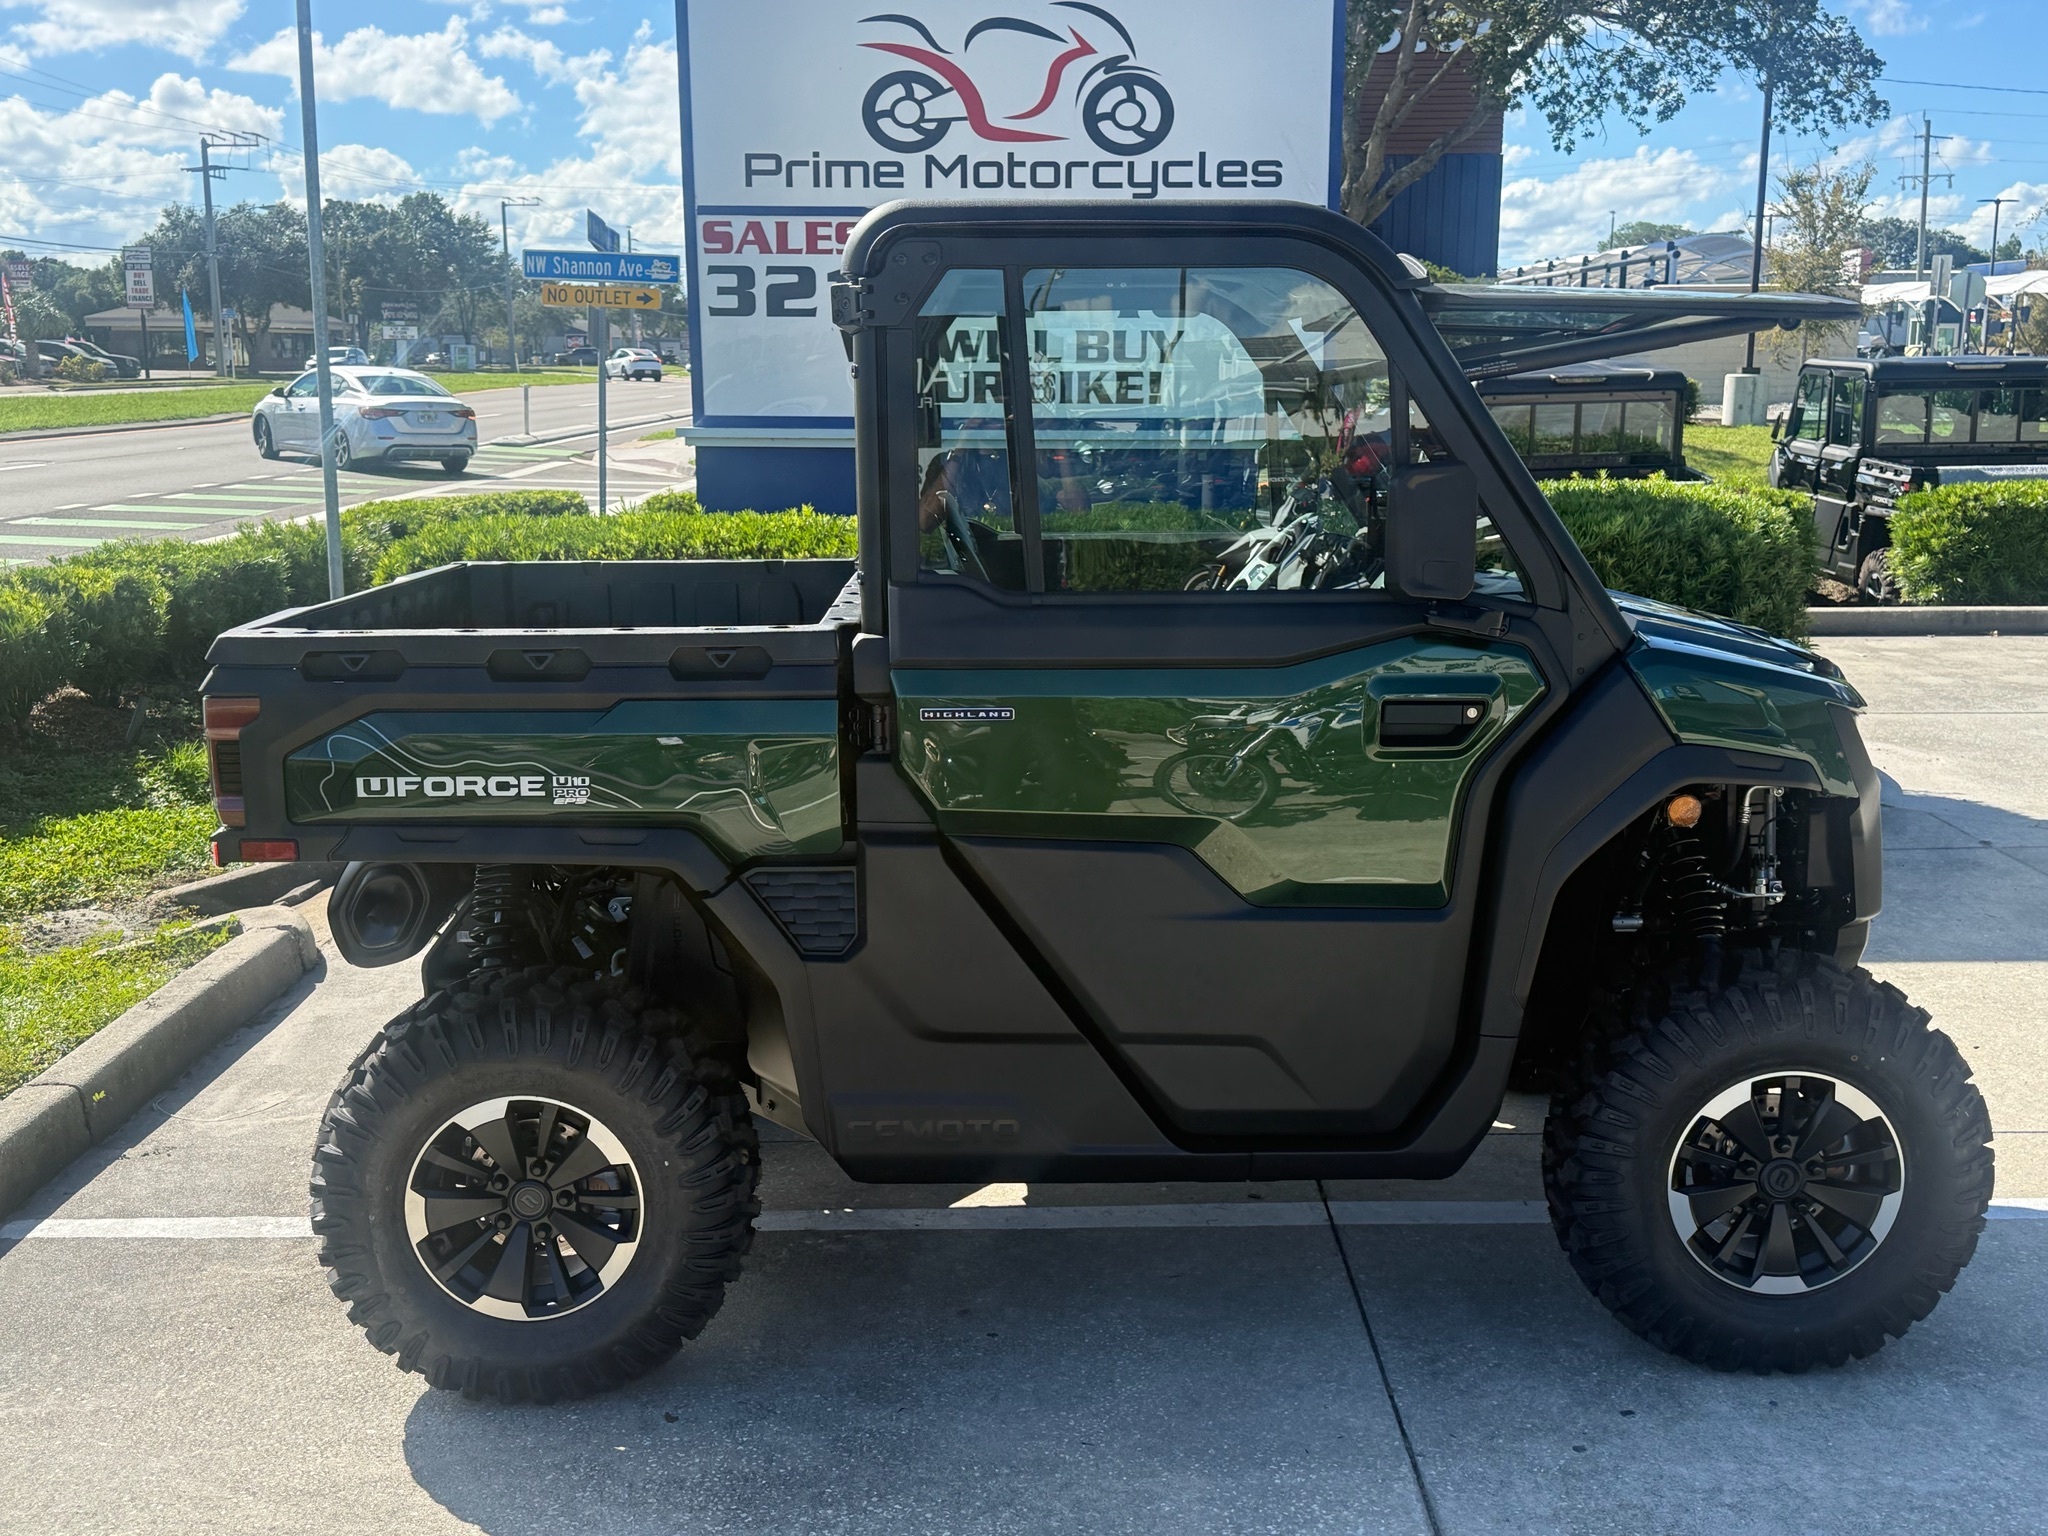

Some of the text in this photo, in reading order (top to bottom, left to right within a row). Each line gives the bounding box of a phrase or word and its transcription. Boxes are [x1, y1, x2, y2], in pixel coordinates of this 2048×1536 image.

[744, 152, 1283, 199] Prime Motorcycles
[702, 220, 858, 255] SALES
[526, 255, 643, 277] NW Shannon Ave
[547, 288, 631, 305] NO OUTLET
[1075, 330, 1185, 364] BUY
[552, 776, 590, 787] U10
[553, 787, 591, 798] PRO
[553, 797, 588, 805] EPS
